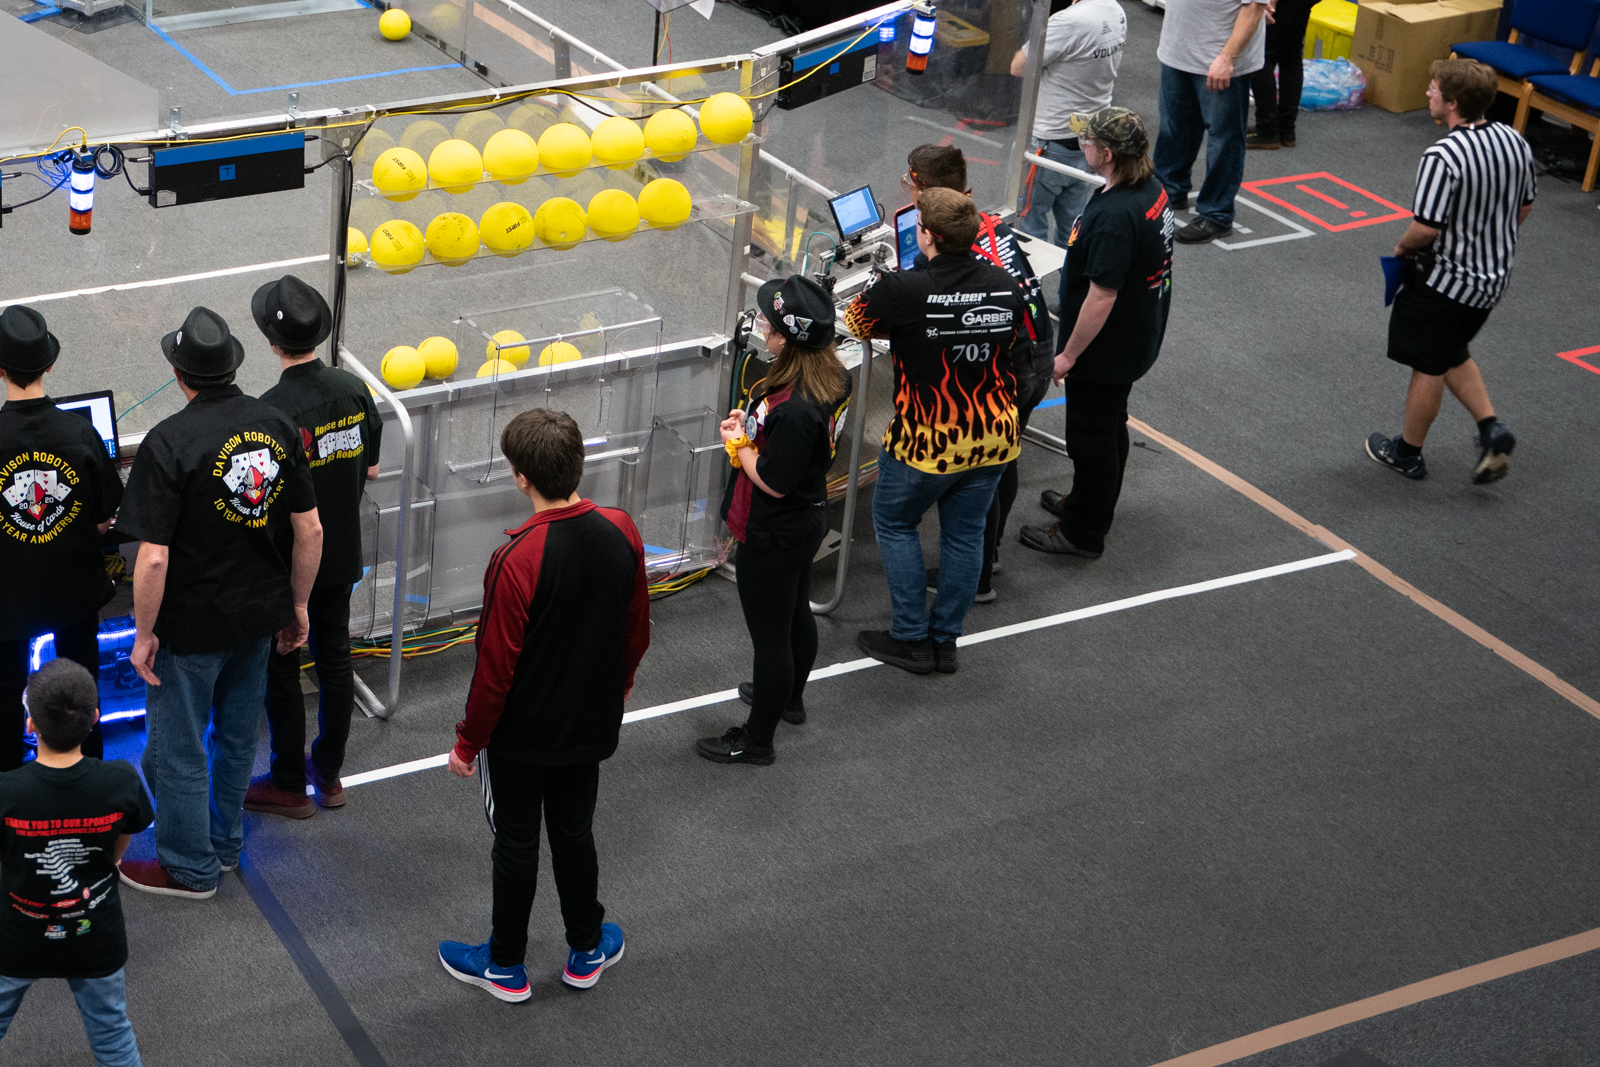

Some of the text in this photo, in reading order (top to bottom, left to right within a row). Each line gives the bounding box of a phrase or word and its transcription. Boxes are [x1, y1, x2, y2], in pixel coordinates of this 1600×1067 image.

[926, 292, 987, 306] nexteer
[961, 312, 1013, 325] GARBER
[952, 342, 990, 363] 703
[315, 412, 365, 436] House of Cards
[212, 431, 286, 477] DAVISON ROBOTICS
[336, 444, 364, 459] Robotics
[33, 451, 80, 485] ROBOTICS
[10, 504, 65, 532] House of Cards
[214, 498, 243, 523] 10 YEAR
[229, 497, 250, 514] House
[252, 505, 262, 517] of
[2, 521, 28, 542] YEAR
[30, 500, 83, 544] ANNIVERSARY
[4, 812, 124, 829] THANK YOU TO OUR SPONSORS
